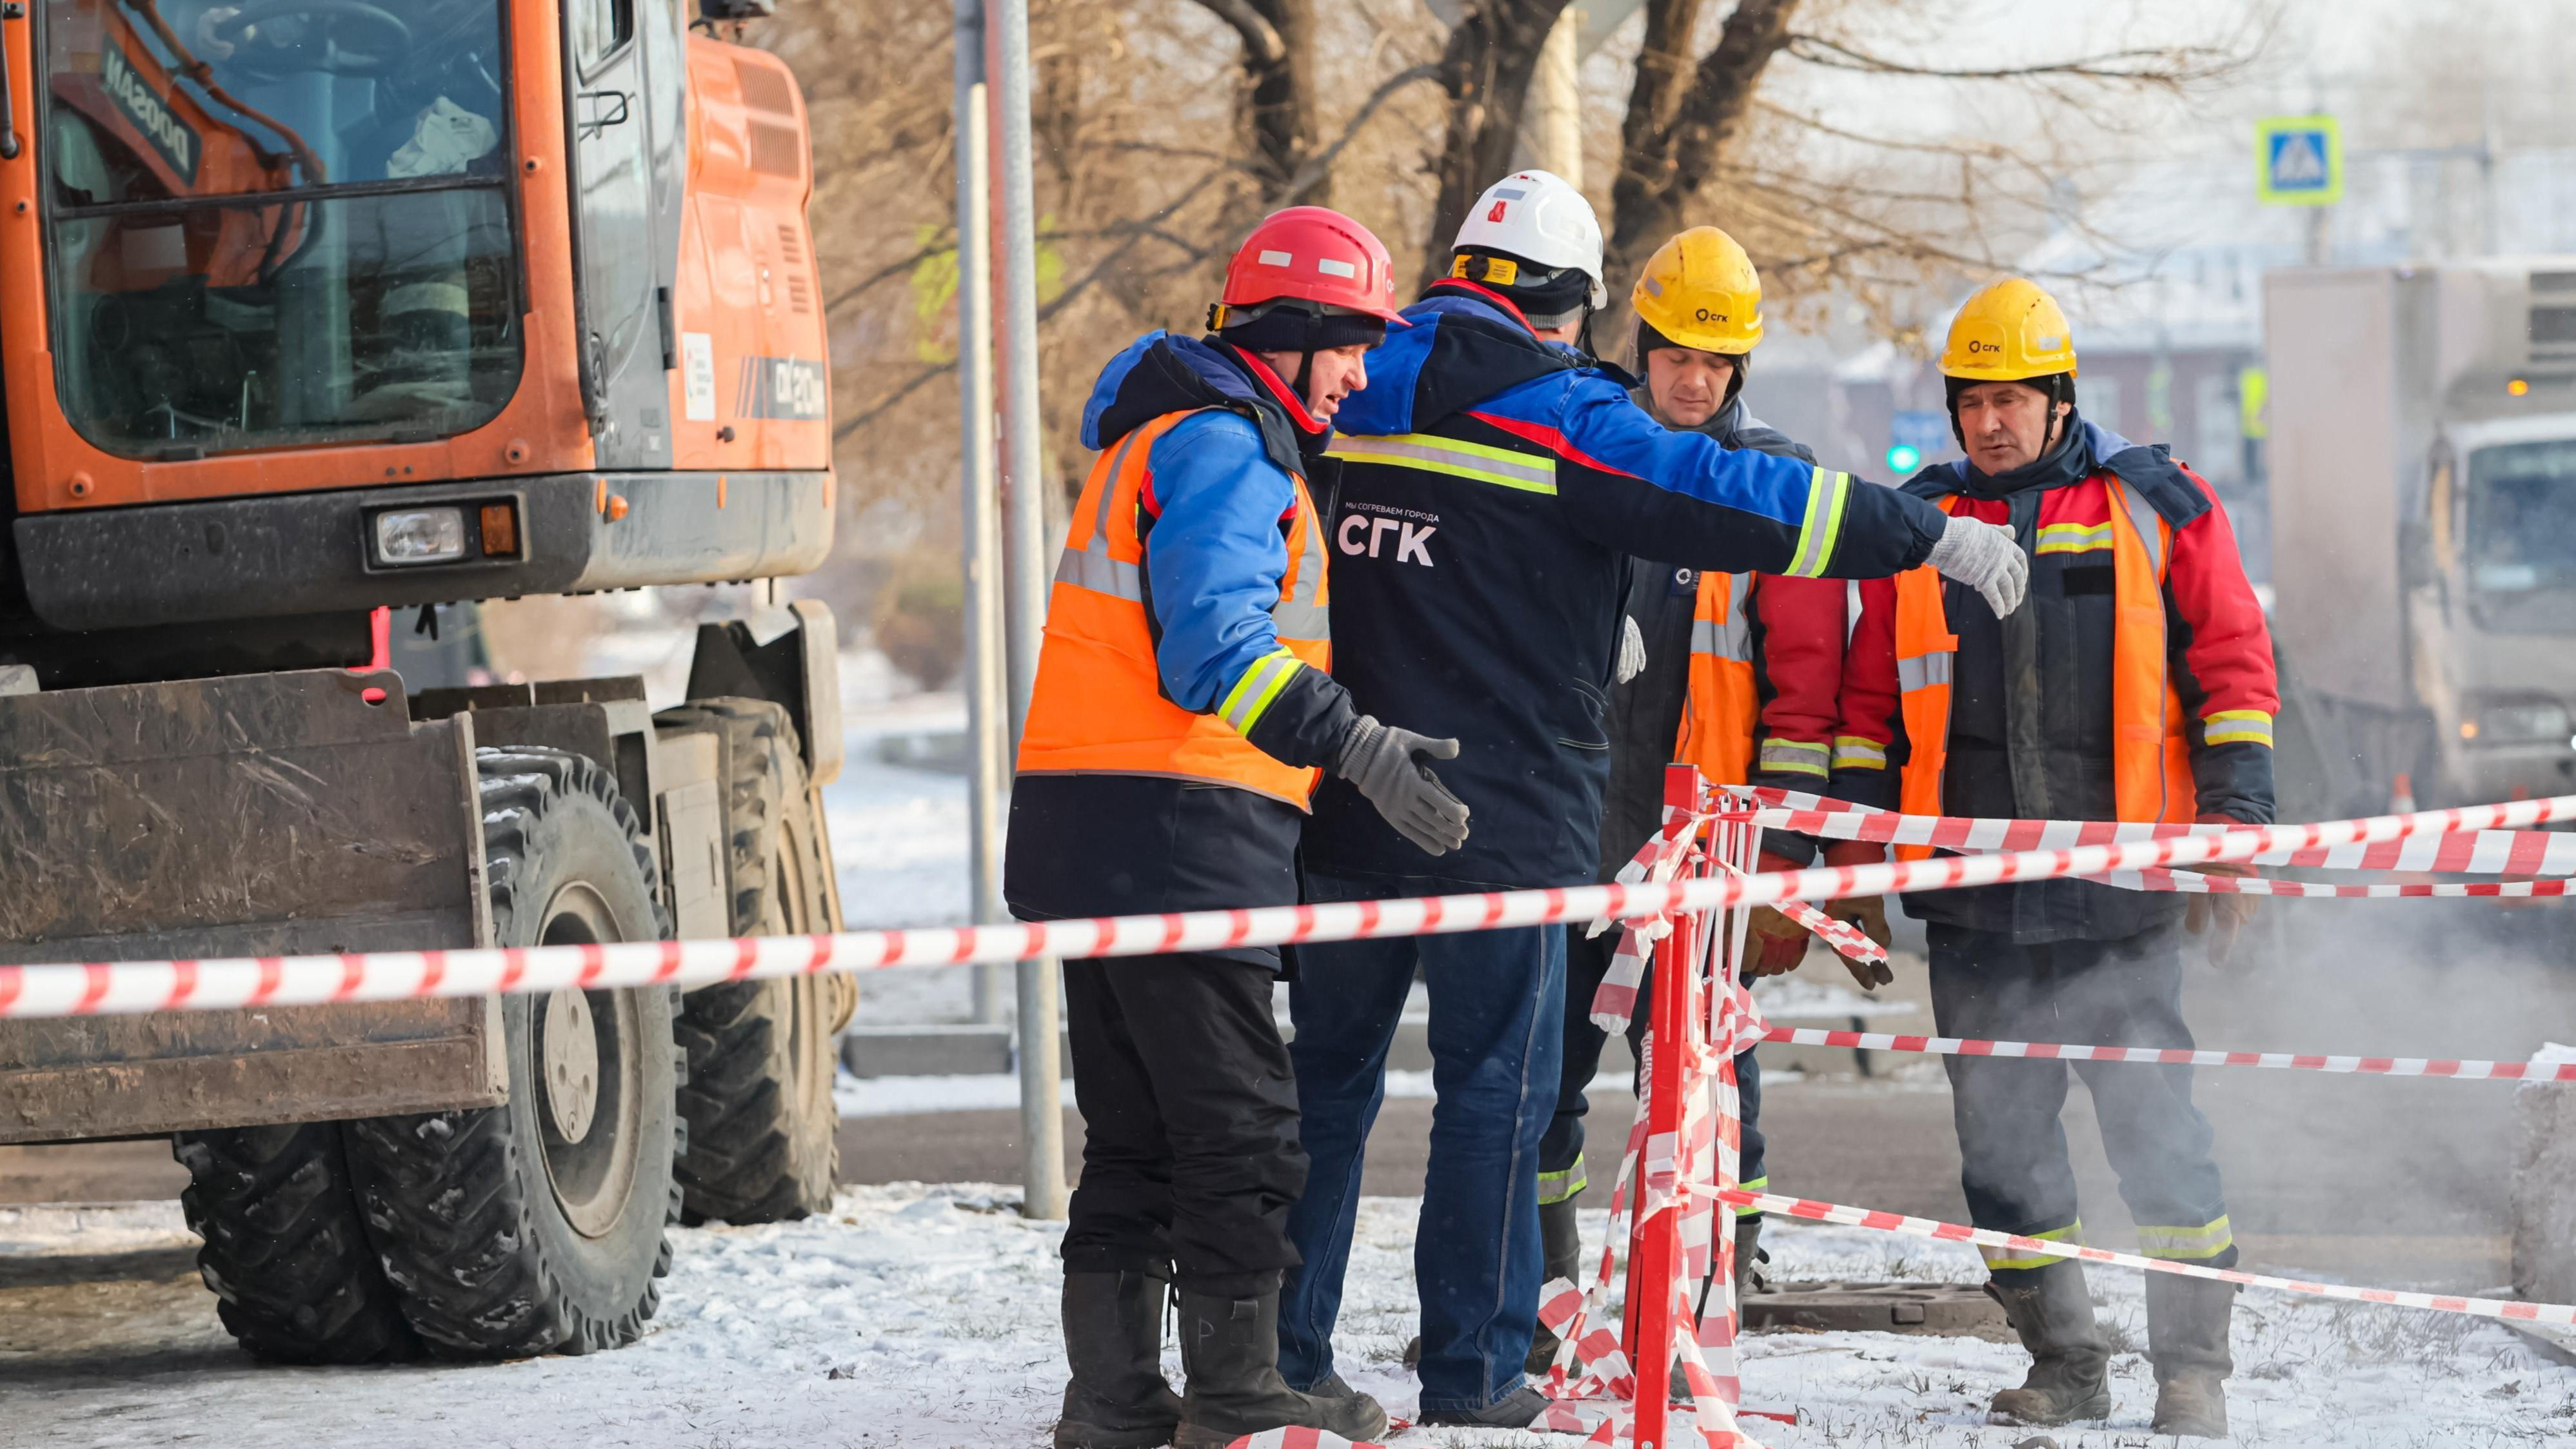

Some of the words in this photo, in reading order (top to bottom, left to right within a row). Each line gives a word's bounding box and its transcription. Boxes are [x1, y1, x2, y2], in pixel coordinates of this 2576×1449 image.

[1710, 313, 1728, 322] СГК
[1983, 344, 2000, 352] СГК
[1358, 502, 1403, 515] СОГРЕВАЕМ
[1404, 509, 1440, 523] ГОРОДА
[1338, 514, 1437, 567] СГК
